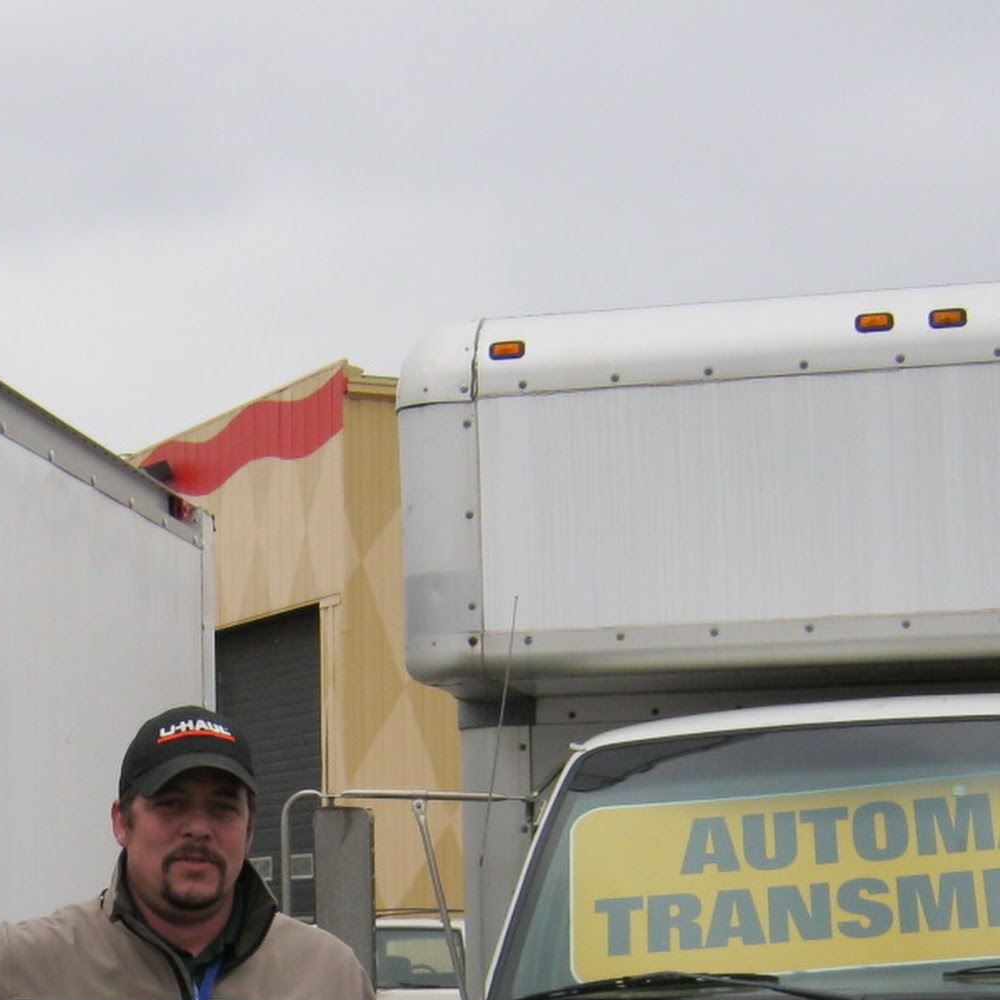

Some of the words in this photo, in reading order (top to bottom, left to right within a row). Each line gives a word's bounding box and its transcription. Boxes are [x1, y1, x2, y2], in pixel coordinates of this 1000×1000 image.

[159, 719, 232, 738] U-HAUL
[680, 792, 1000, 875] AUTOM
[594, 867, 1000, 957] TRANSMI
